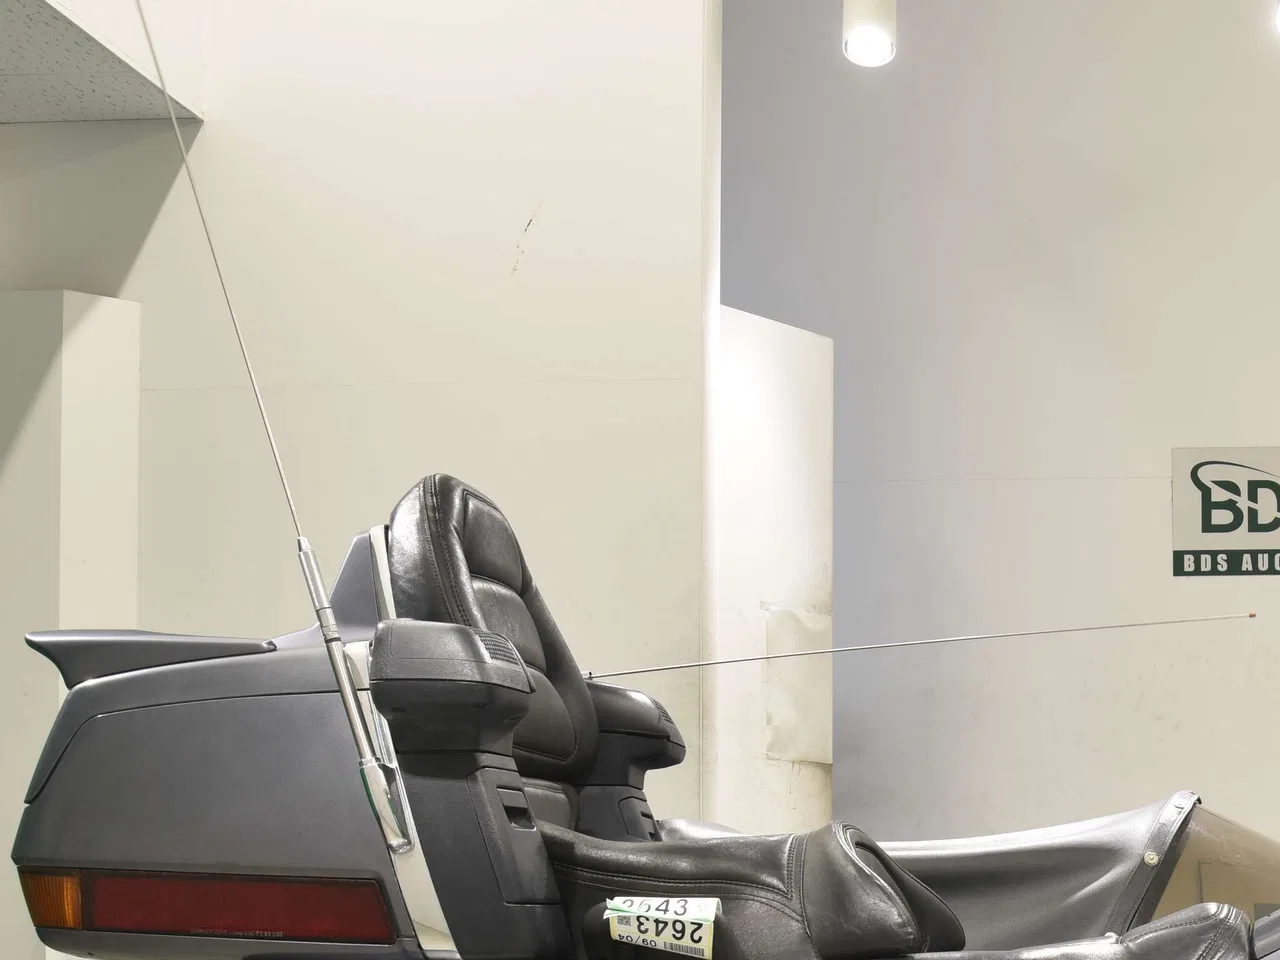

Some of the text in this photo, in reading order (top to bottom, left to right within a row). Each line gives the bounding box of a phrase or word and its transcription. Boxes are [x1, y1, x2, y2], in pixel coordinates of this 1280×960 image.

[1183, 553, 1228, 572] BDS
[635, 915, 704, 944] 2643
[618, 933, 657, 948] 09/04
